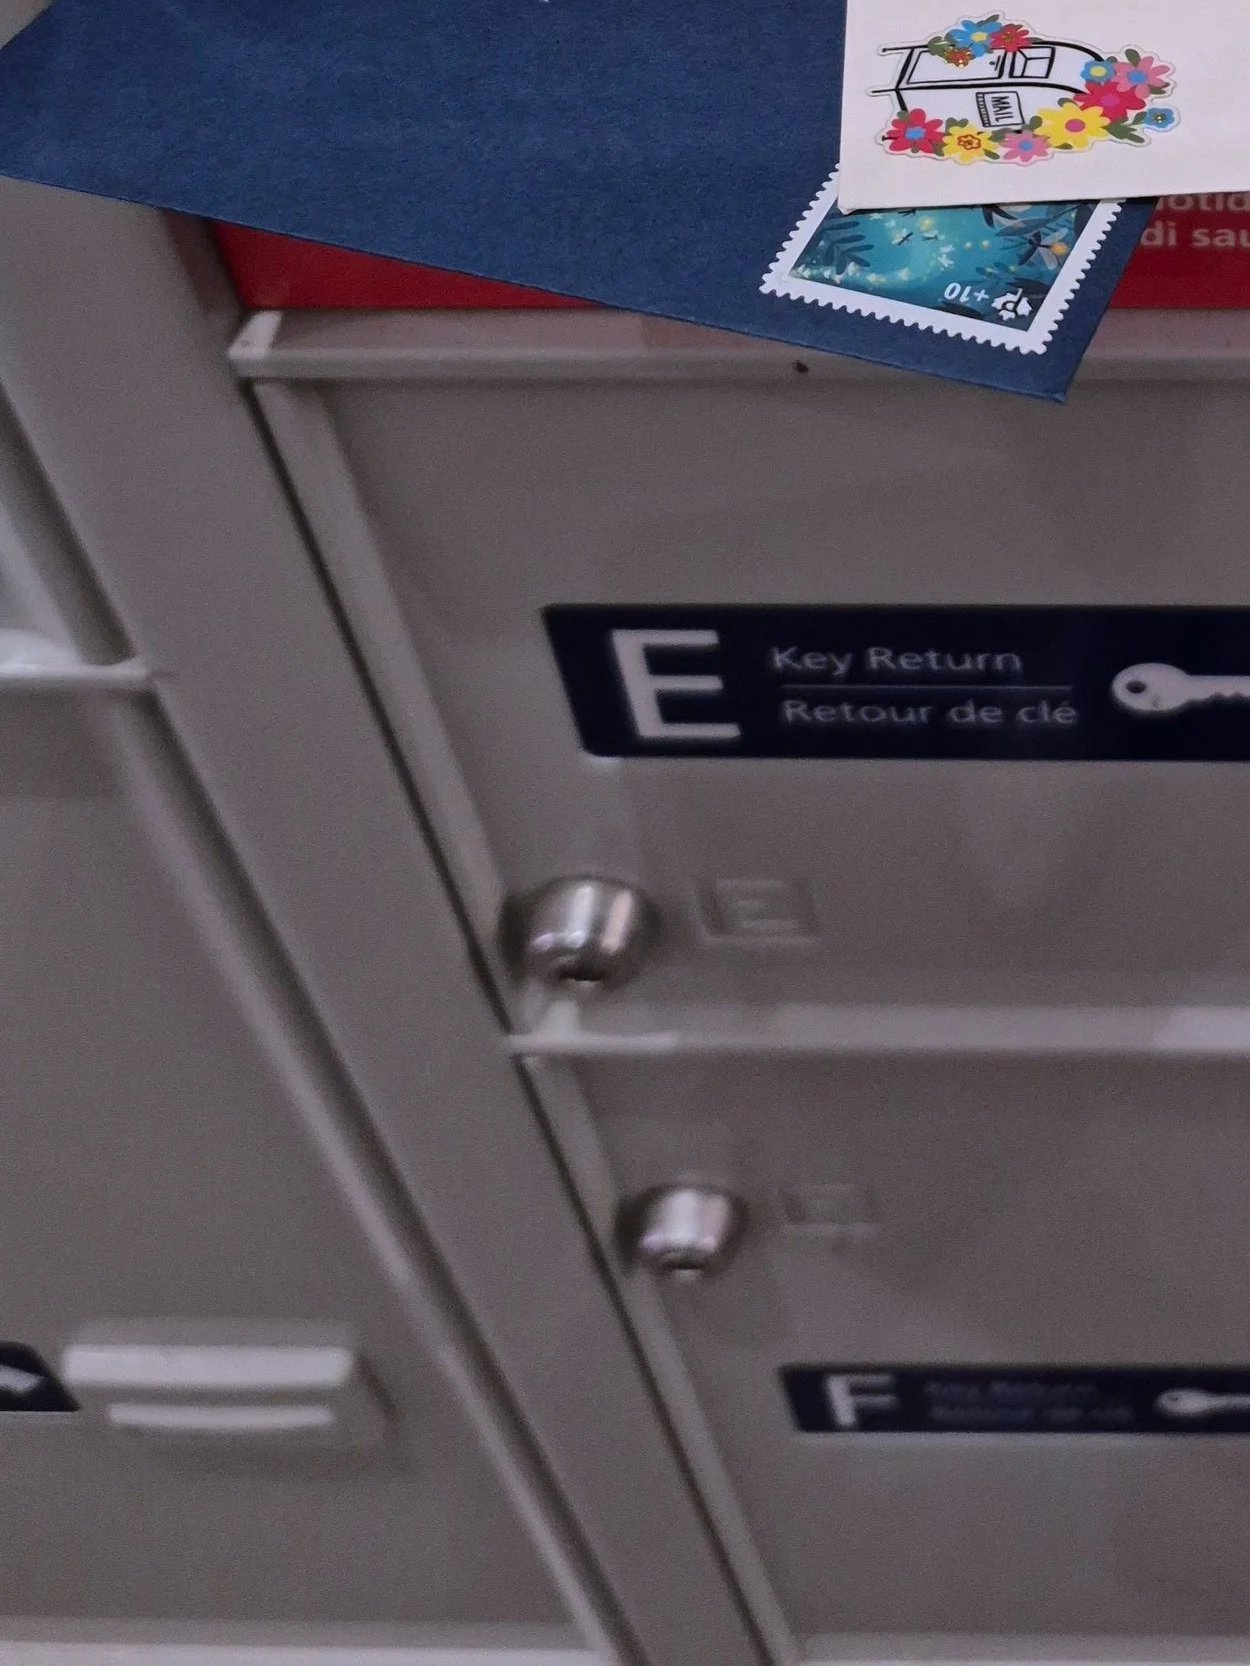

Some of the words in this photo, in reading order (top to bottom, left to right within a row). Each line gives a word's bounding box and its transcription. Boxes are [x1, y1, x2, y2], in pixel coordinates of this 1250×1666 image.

[990, 95, 1015, 123] MAIL
[770, 645, 852, 677] Key
[865, 646, 1024, 672] Return
[612, 628, 741, 739] E
[780, 698, 934, 725] Retour
[948, 698, 1005, 725] de
[1016, 698, 1078, 725] clé
[825, 1373, 897, 1428] F
